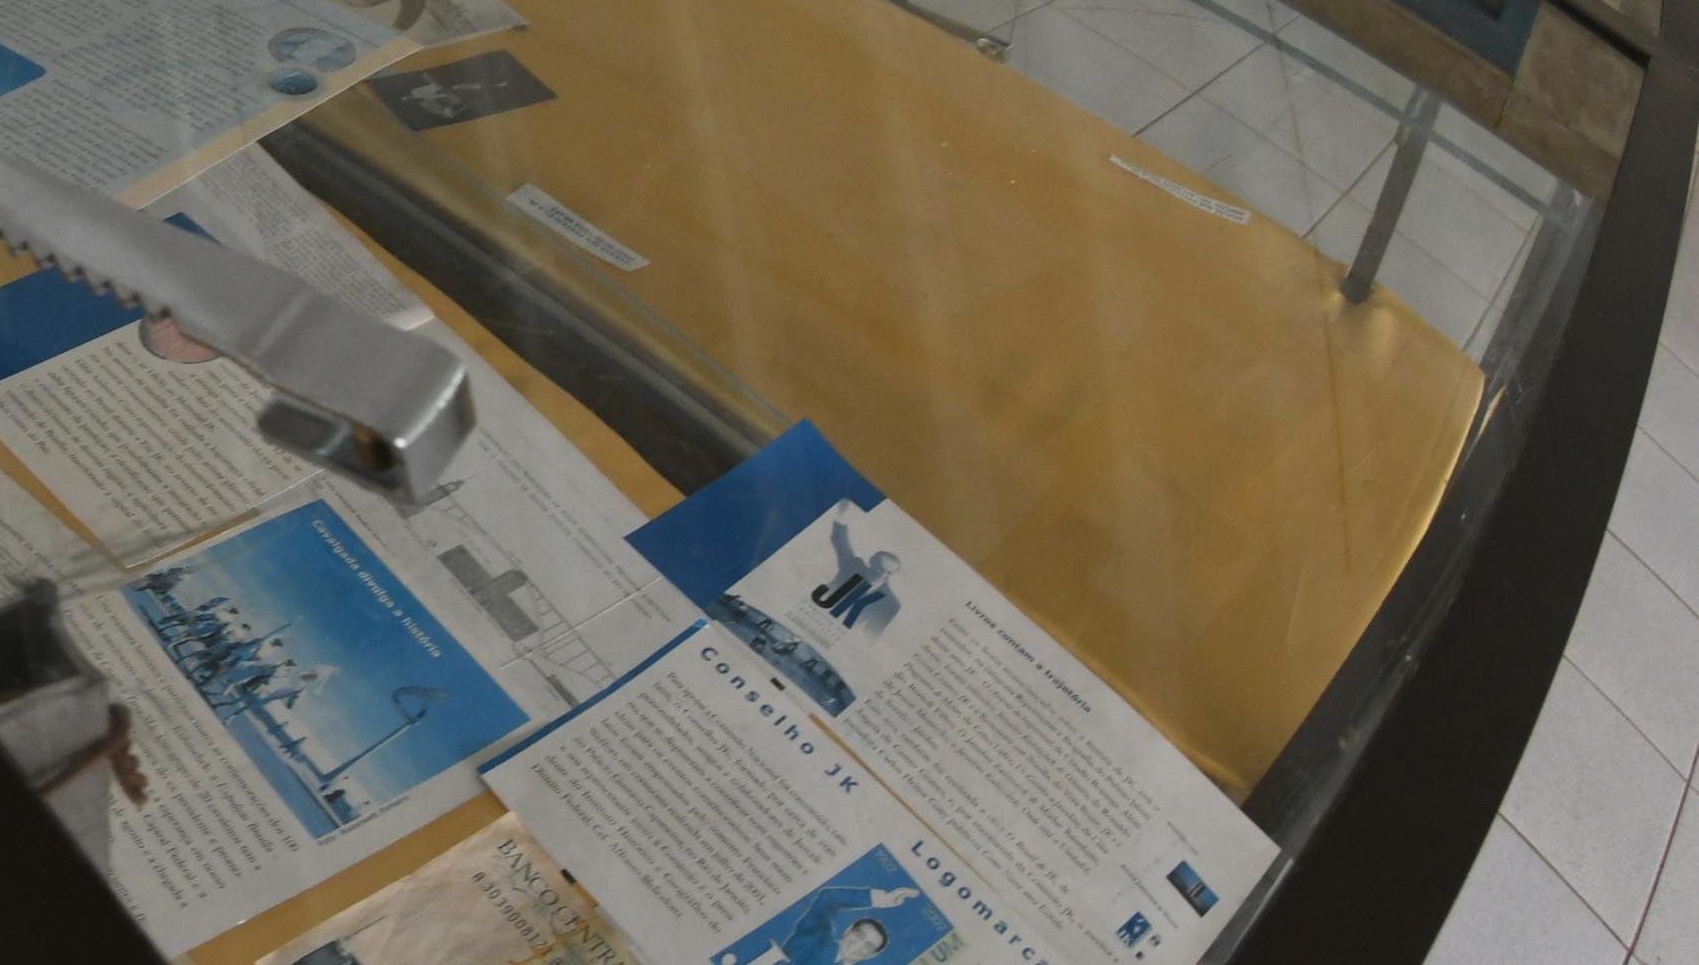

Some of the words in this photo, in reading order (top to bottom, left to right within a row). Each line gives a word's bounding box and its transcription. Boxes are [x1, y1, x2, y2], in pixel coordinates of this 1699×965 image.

[312, 519, 359, 570] Cavalgada
[357, 571, 394, 608] divulga
[392, 609, 403, 617] a
[401, 616, 440, 657] história
[810, 573, 886, 630] JK
[965, 600, 996, 629] Livros
[997, 629, 1034, 662] contam
[1043, 669, 1091, 713] trajetória
[700, 646, 816, 757] Conselho
[824, 762, 860, 796] JK
[495, 838, 560, 906] BANCO
[554, 905, 627, 965] CENTR
